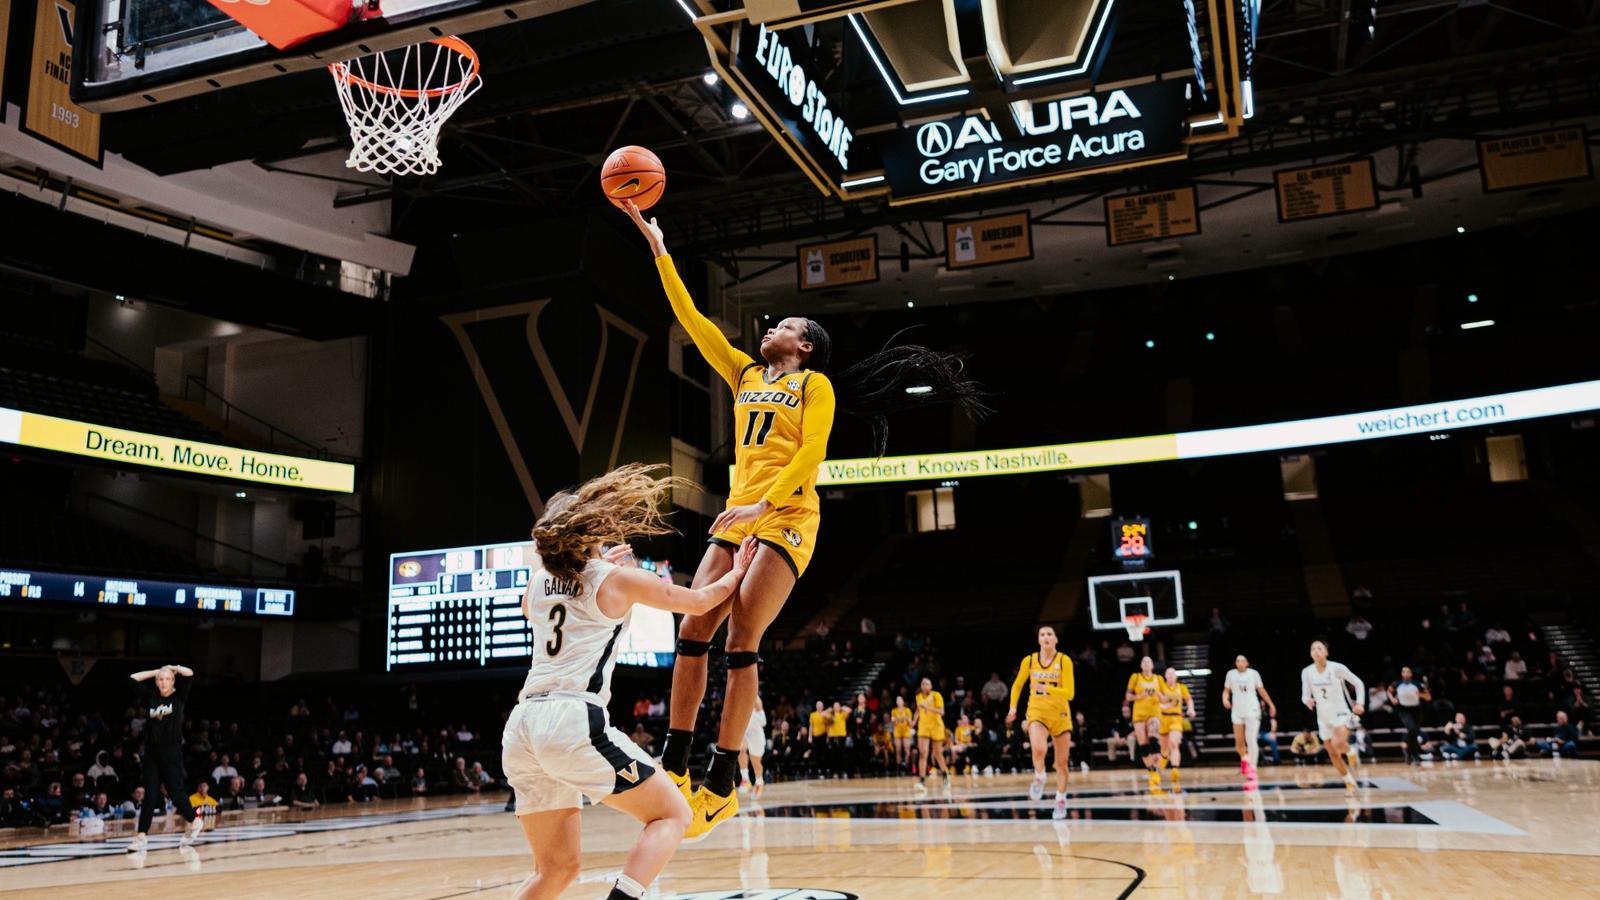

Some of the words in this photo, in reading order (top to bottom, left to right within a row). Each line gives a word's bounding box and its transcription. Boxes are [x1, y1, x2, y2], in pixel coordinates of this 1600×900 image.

[45, 61, 68, 85] FINAL
[59, 52, 71, 69] NC
[51, 103, 80, 128] 1993
[953, 89, 1142, 149] AURA
[919, 155, 985, 184] Gary
[988, 141, 1062, 174] Force
[1067, 128, 1145, 161] Acura
[742, 410, 777, 448] 11
[1357, 403, 1505, 433] weichert.com
[86, 429, 165, 461] Dream.
[173, 444, 233, 472] Move.
[241, 455, 304, 482] Home.
[917, 458, 980, 475] Knows
[985, 450, 1073, 471] Nashville.
[1120, 536, 1145, 557] 28
[546, 603, 567, 656] 3
[617, 760, 640, 784] V
